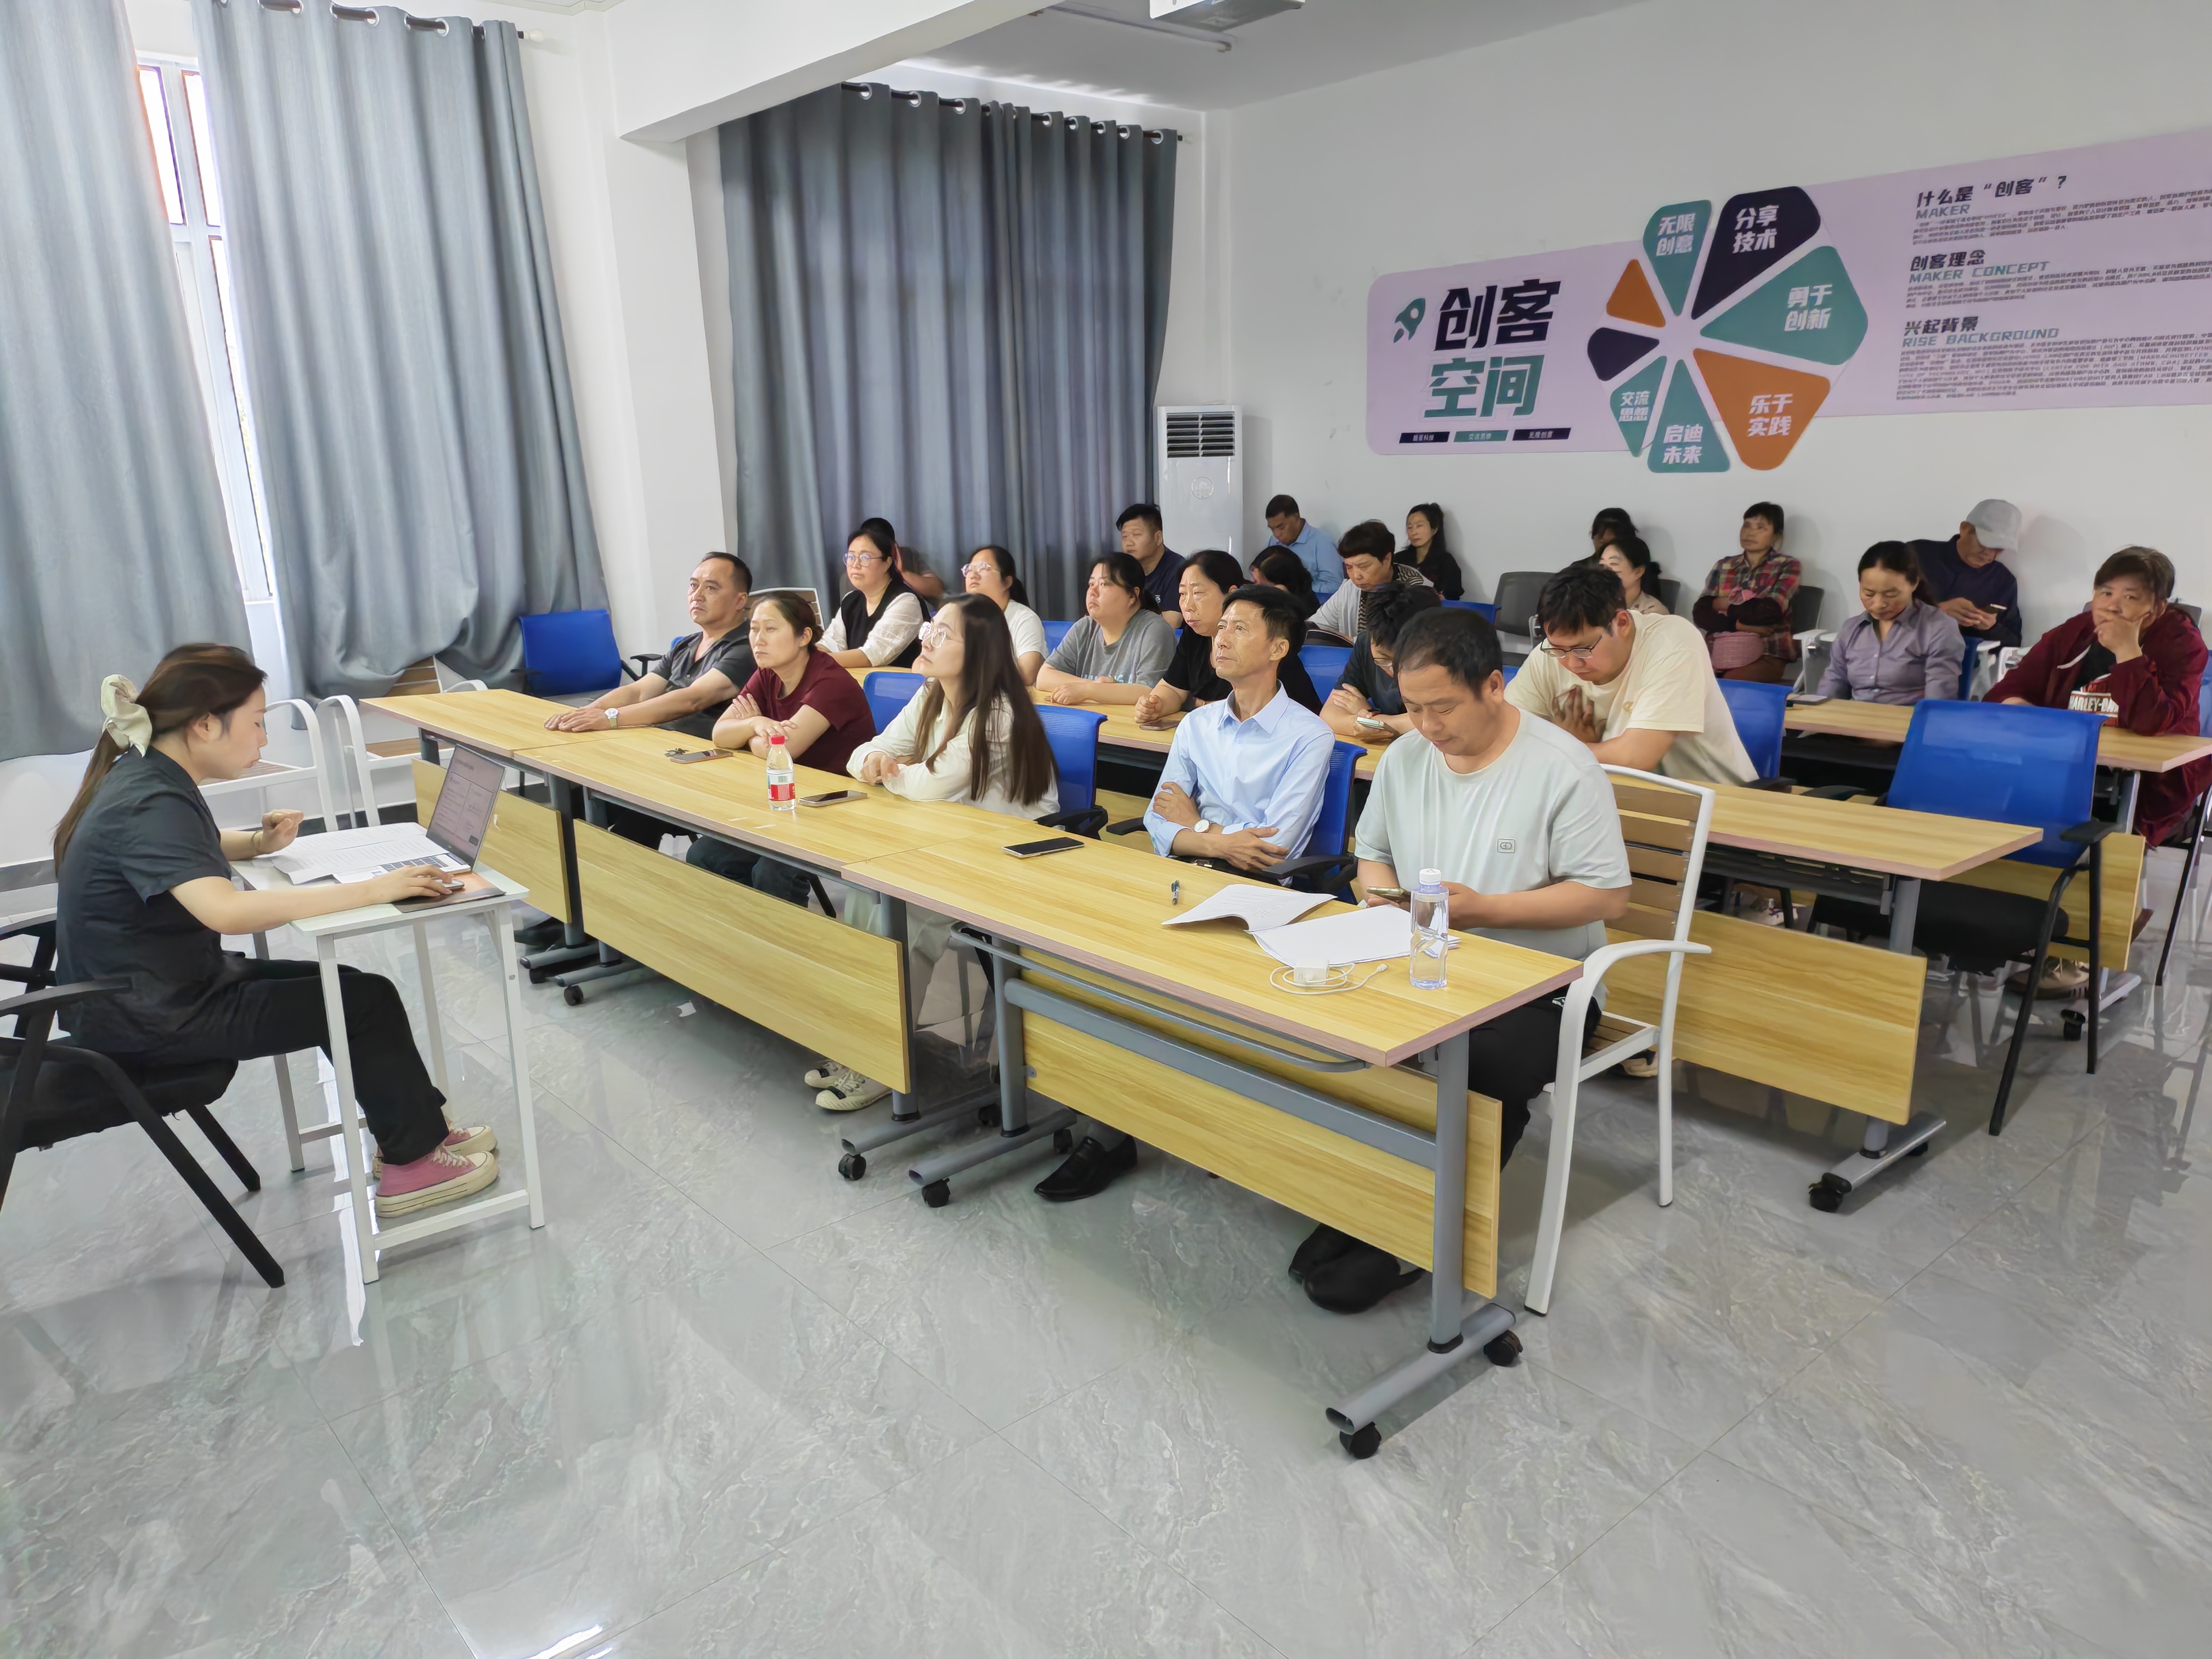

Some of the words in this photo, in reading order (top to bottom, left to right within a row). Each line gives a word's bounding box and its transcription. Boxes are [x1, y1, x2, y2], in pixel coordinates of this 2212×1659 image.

[1735, 205, 1779, 230] 分享
[1915, 204, 1970, 219] MAKER
[1657, 213, 1696, 236] 无限
[1656, 235, 1694, 256] 创意
[1733, 228, 1778, 254] 技术
[1910, 250, 1985, 272] 创客理念
[1909, 269, 1963, 284] MAKER
[1972, 261, 2050, 278] CONCEPT
[1788, 284, 1833, 308] 勇于
[1434, 279, 1561, 351] 创客
[1784, 308, 1832, 331] 创新
[1904, 316, 1979, 336] 兴起背景
[1902, 336, 1938, 348] RISE
[1946, 328, 2059, 345] BACKGROUND
[1424, 354, 1544, 418] 空间
[1620, 391, 1650, 406] 交流
[1748, 394, 1793, 414] 乐于
[1618, 407, 1649, 422] 思想
[1663, 423, 1703, 443] 启迪
[1747, 415, 1792, 437] 实践
[1662, 445, 1702, 464] 未来
